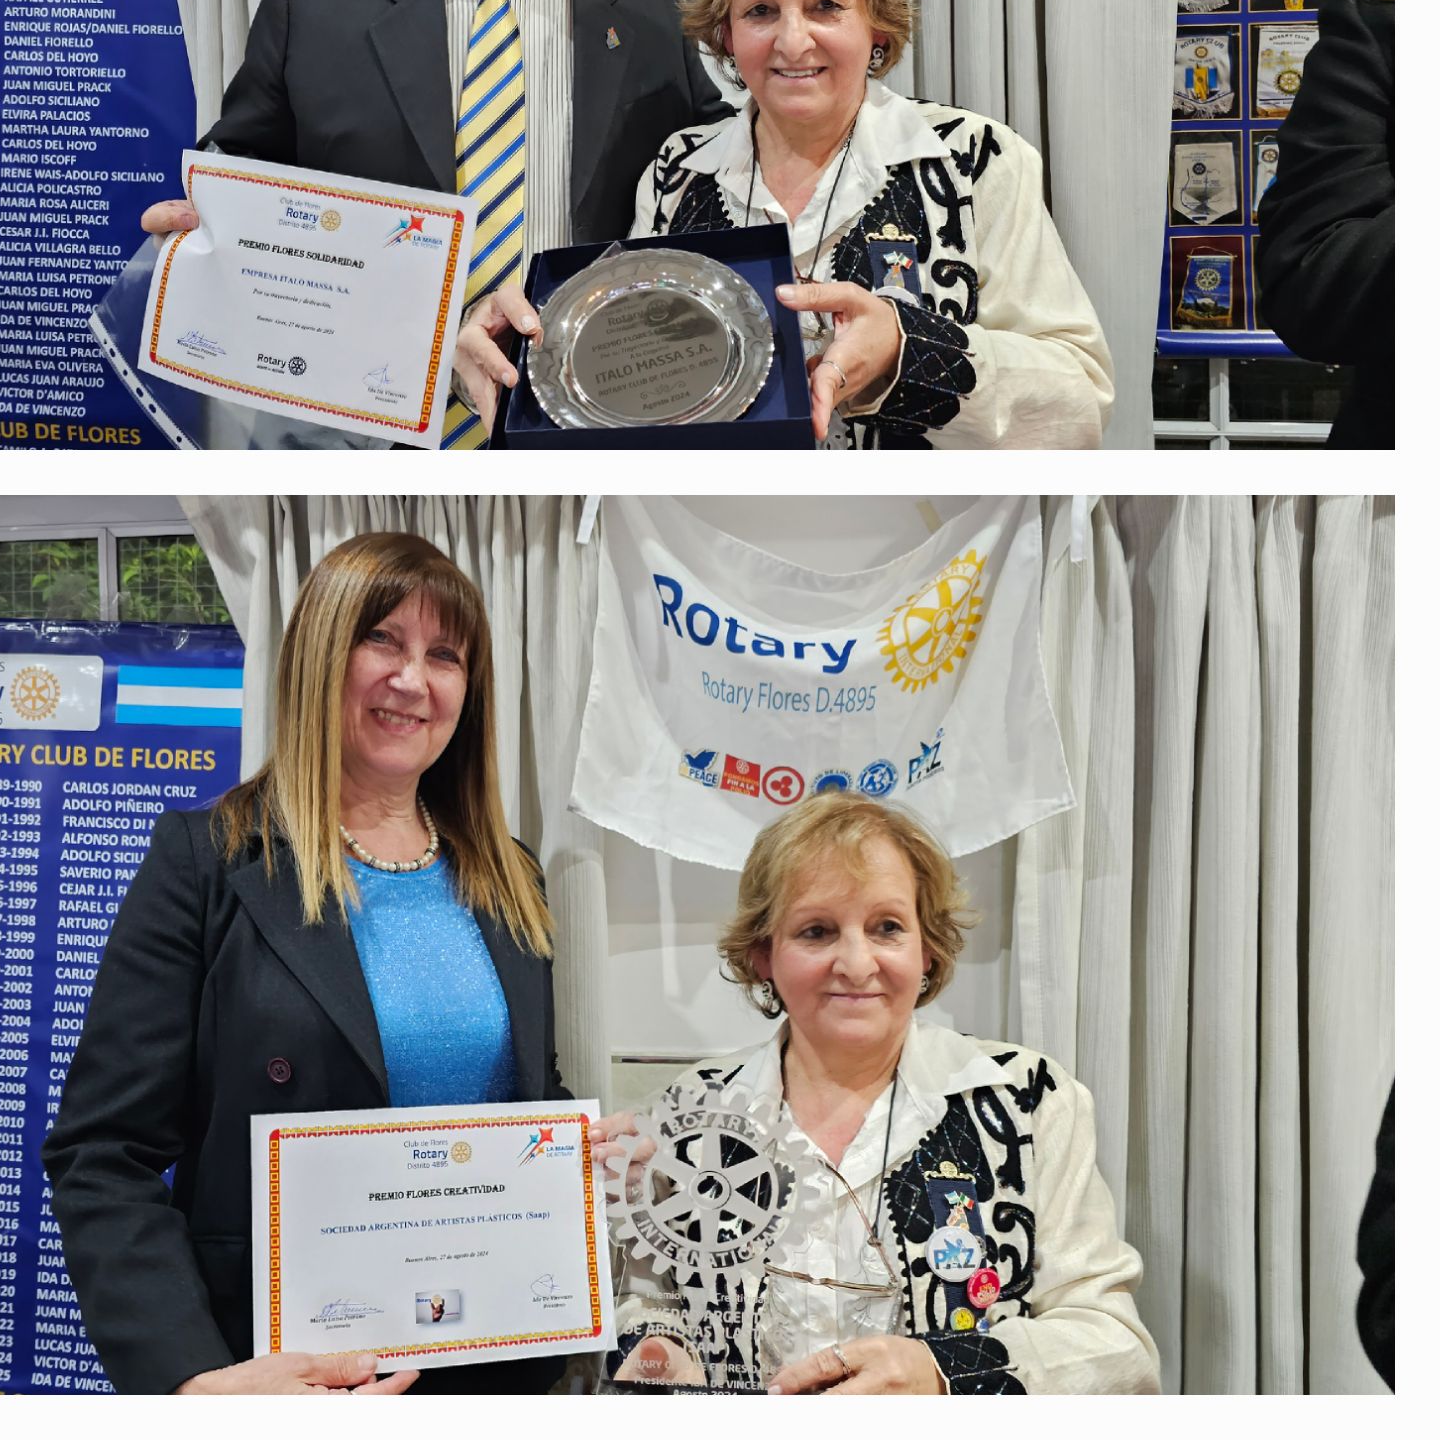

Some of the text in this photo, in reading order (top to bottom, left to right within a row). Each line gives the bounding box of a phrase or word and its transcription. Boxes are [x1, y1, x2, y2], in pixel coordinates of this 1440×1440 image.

[2, 124, 48, 135] MARTHA
[51, 126, 87, 137] LAURA
[89, 126, 150, 138] YANTORNO
[0, 182, 35, 193] ALICIA
[38, 183, 102, 196] POLICASTRO
[286, 207, 319, 223] Rotary
[238, 238, 364, 269] PREMIO FLORES SOLIDARIDAD
[257, 353, 287, 368] Rotary
[595, 344, 713, 384] ITALO MASSA S.A.
[32, 374, 59, 386] JUAN
[62, 376, 105, 388] ARAUJO
[35, 422, 61, 441] DE
[67, 425, 141, 445] FLORES
[653, 573, 857, 674] Rotary
[702, 672, 877, 714] Rotary Flores D.4895
[31, 744, 88, 766] CLUB
[95, 747, 124, 768] DE
[131, 748, 217, 771] FLORES
[689, 768, 718, 786] PEACE
[403, 1140, 419, 1148] Club
[421, 1140, 429, 1148] de
[413, 1149, 448, 1161] Rotary
[407, 1160, 448, 1170] Distrito 4895
[368, 1184, 505, 1202] PREMIO FLORES CREATIVIDAD
[320, 1210, 550, 1235] SOCIEDAD ARGENTINA DE ARTISTAS PLÁSTICOS (Saap)
